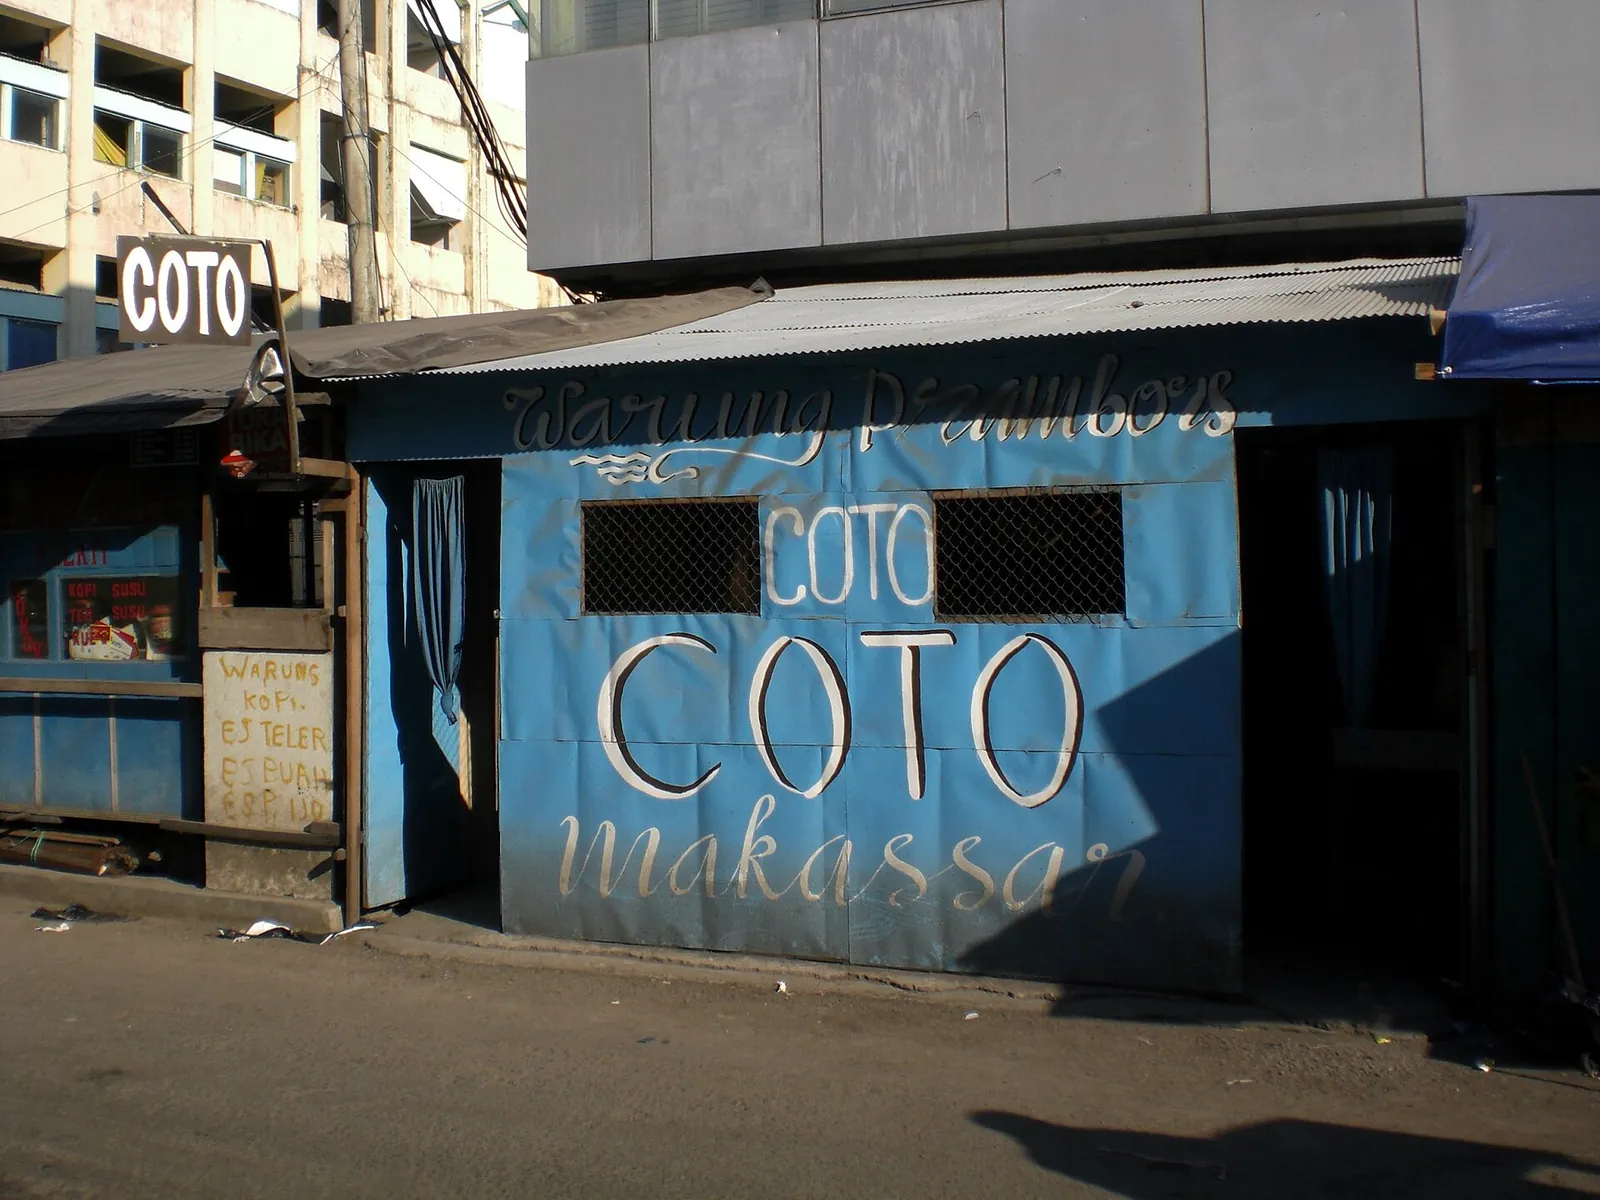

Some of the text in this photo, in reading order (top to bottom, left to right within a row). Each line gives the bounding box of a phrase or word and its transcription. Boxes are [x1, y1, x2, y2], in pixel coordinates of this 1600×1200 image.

[122, 246, 246, 337] COTO
[503, 380, 833, 474] Warung
[764, 502, 934, 606] COTO
[69, 582, 146, 598] KOPI SUSU
[112, 605, 146, 620] SUSU
[260, 720, 328, 752] TELER
[597, 630, 1085, 809] COTO
[264, 756, 329, 791] BUAH
